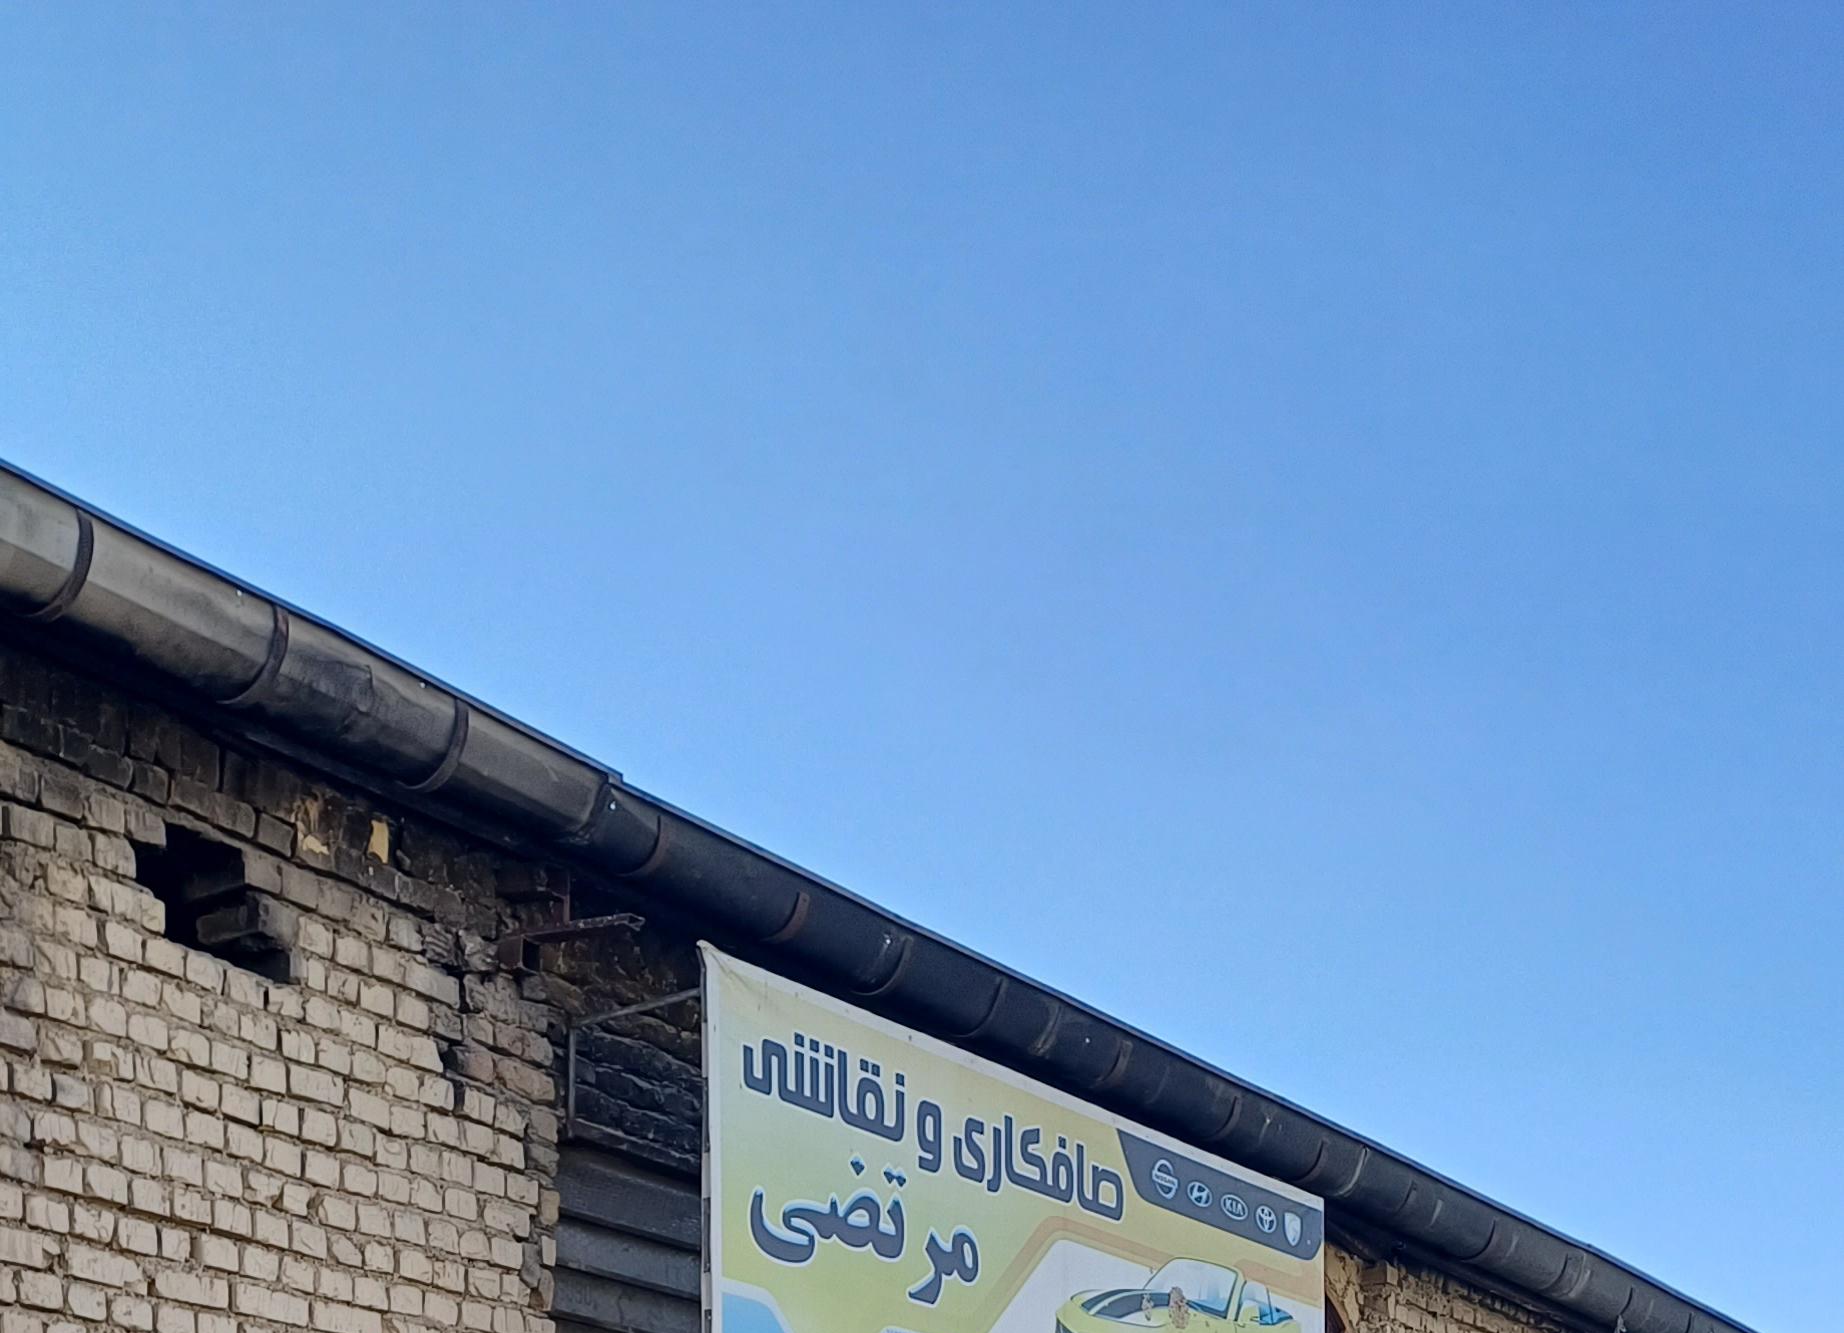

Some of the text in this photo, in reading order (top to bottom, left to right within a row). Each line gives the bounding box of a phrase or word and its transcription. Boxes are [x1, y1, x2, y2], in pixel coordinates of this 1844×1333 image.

[743, 1032, 1124, 1221] صافکاری و نقاشی
[1224, 1198, 1245, 1217] KIA
